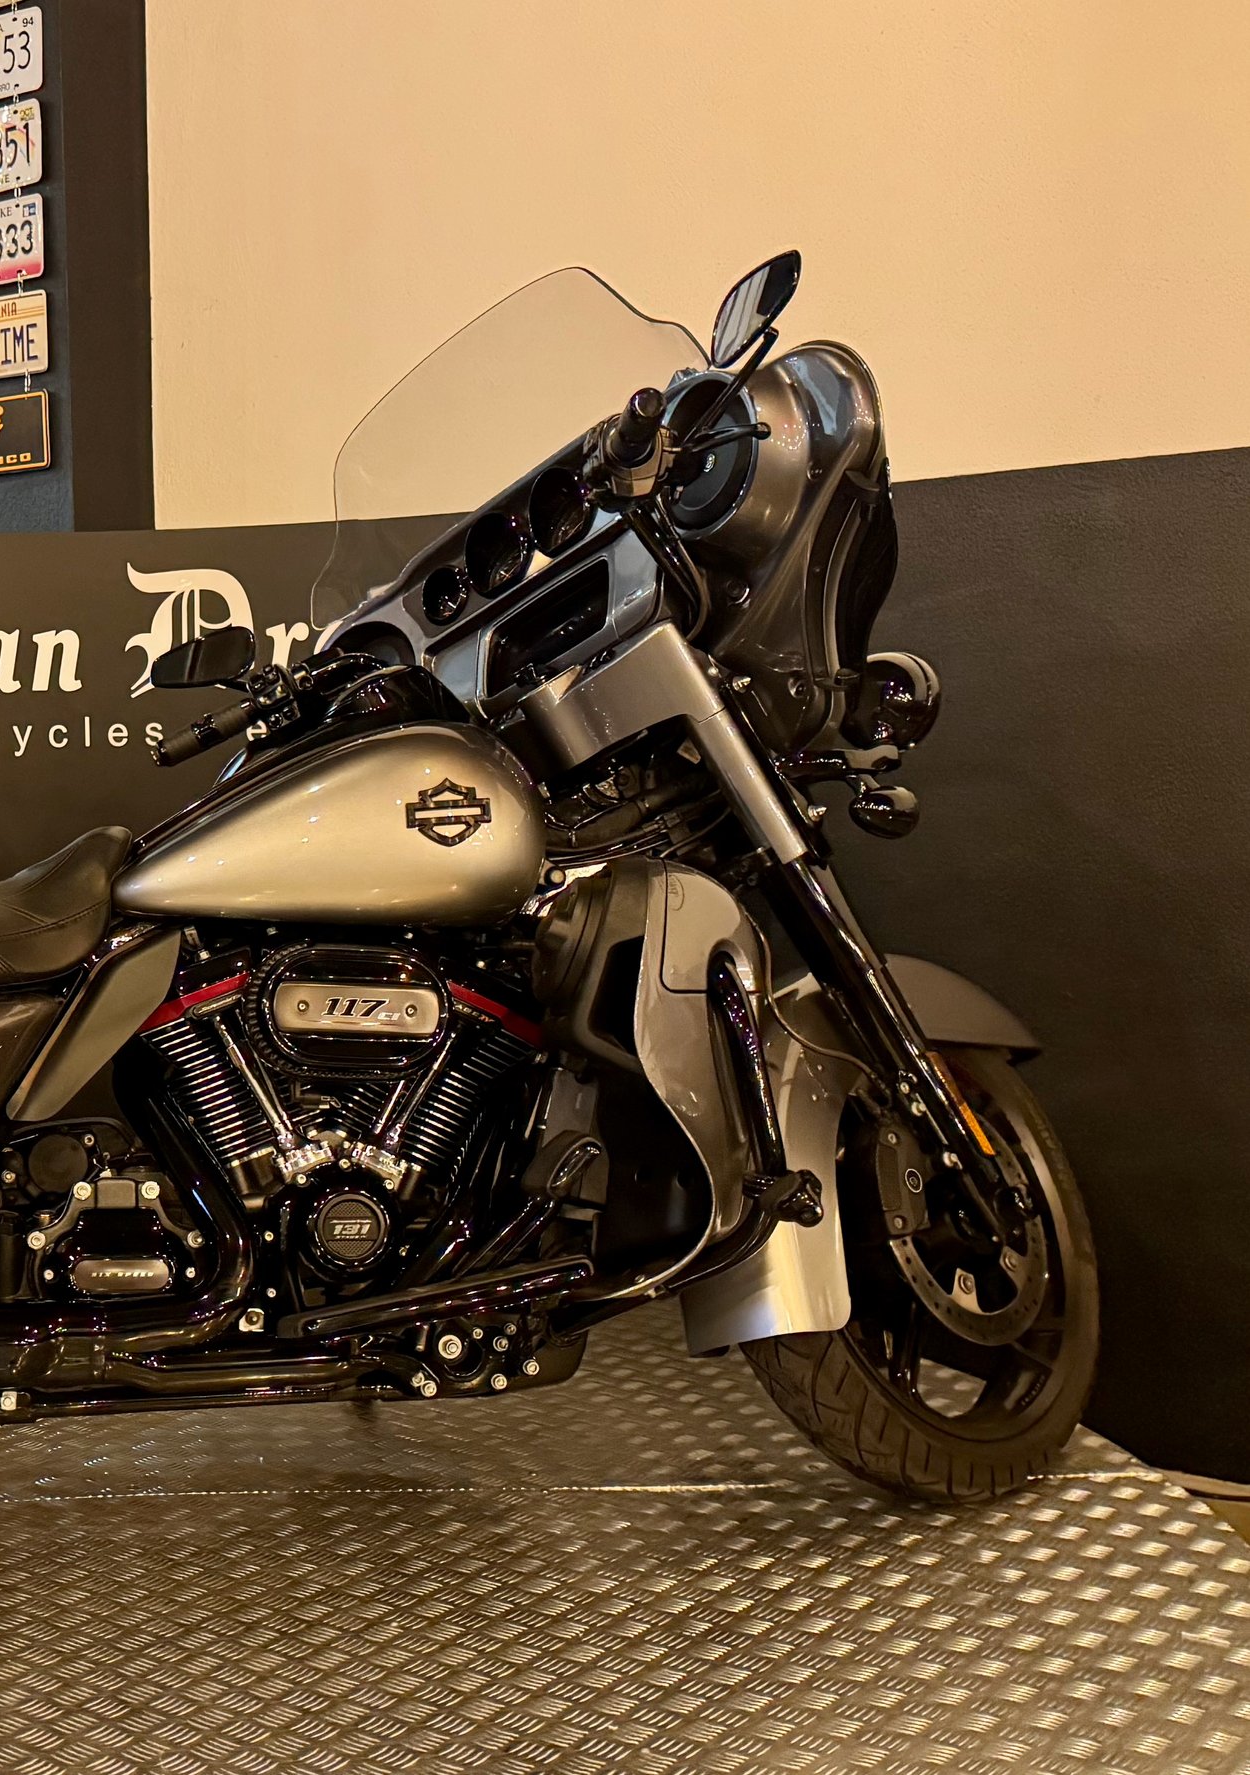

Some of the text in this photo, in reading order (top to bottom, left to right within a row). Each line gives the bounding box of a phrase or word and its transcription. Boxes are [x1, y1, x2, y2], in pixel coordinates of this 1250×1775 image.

[22, 17, 34, 28] 94
[321, 996, 390, 1018] 117
[333, 1224, 371, 1235] 131
